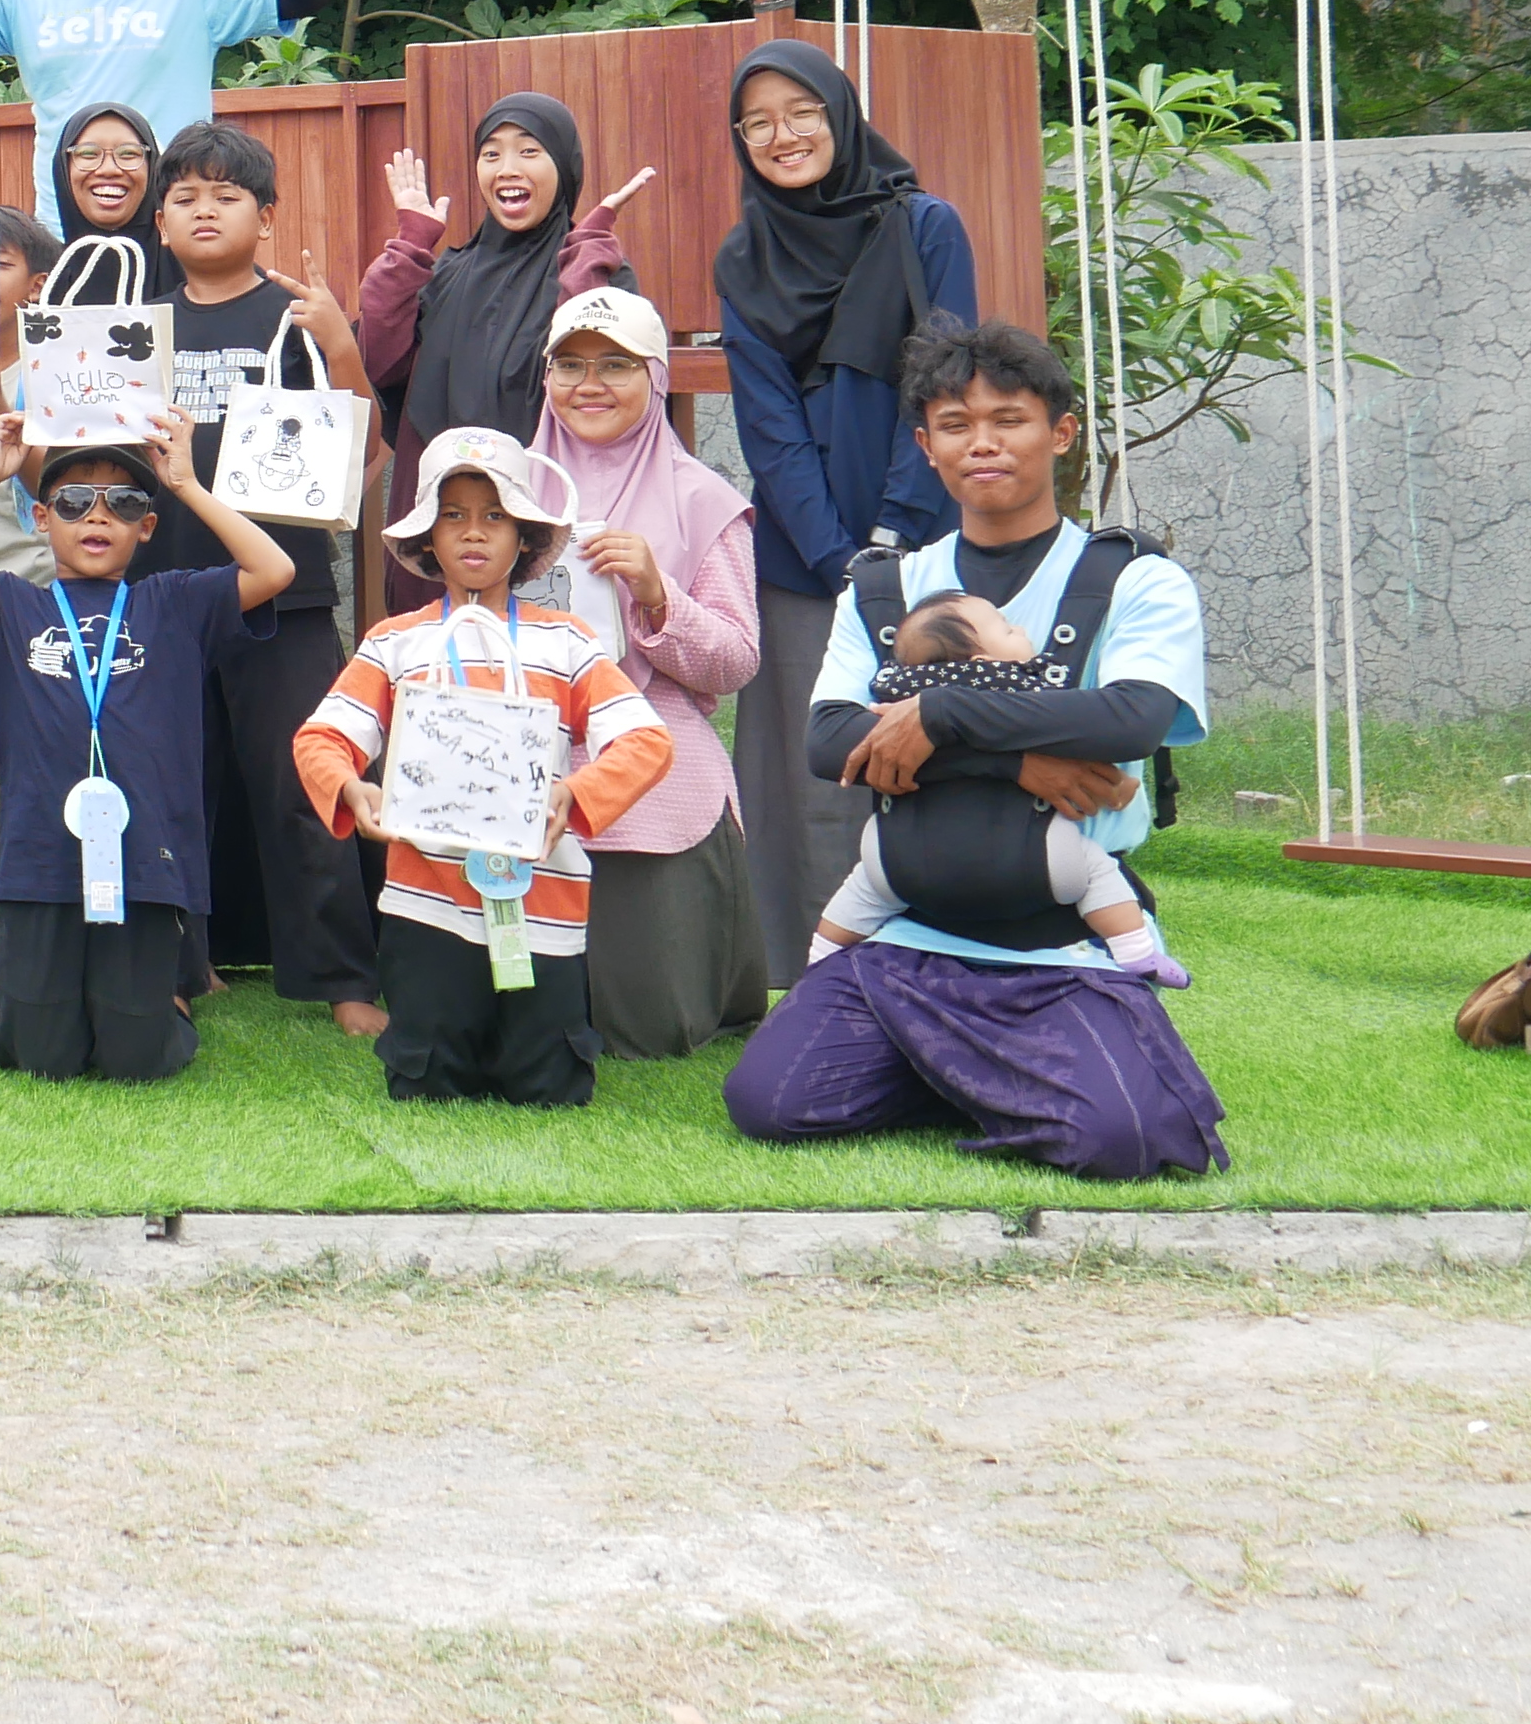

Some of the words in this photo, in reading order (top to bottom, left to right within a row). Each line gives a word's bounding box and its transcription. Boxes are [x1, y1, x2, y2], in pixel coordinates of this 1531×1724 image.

[37, 6, 164, 47] selfa
[574, 309, 620, 322] adidas
[57, 370, 125, 394] HELLO
[63, 392, 120, 406] Autumn
